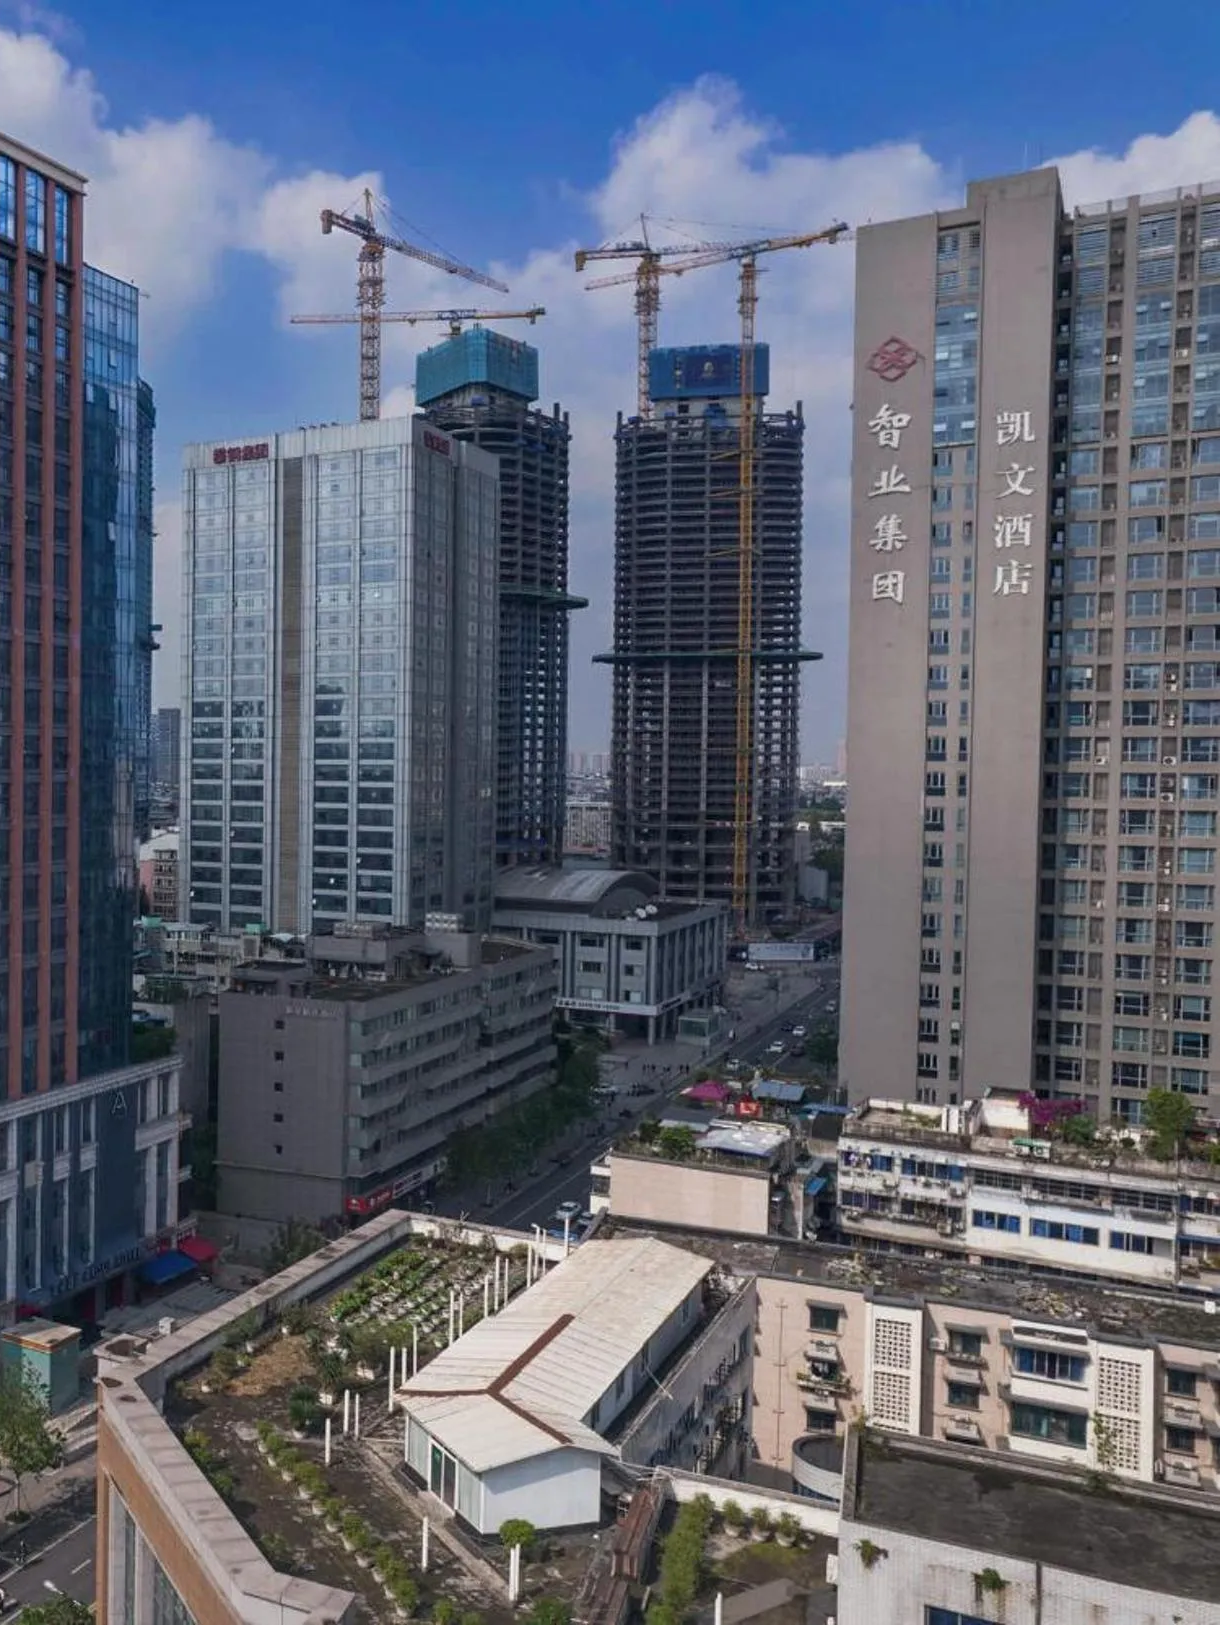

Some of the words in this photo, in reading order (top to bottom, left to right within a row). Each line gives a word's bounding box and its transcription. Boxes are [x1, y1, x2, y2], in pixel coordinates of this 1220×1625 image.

[867, 403, 912, 605] 智业集团
[993, 409, 1037, 597] 凯文酒店
